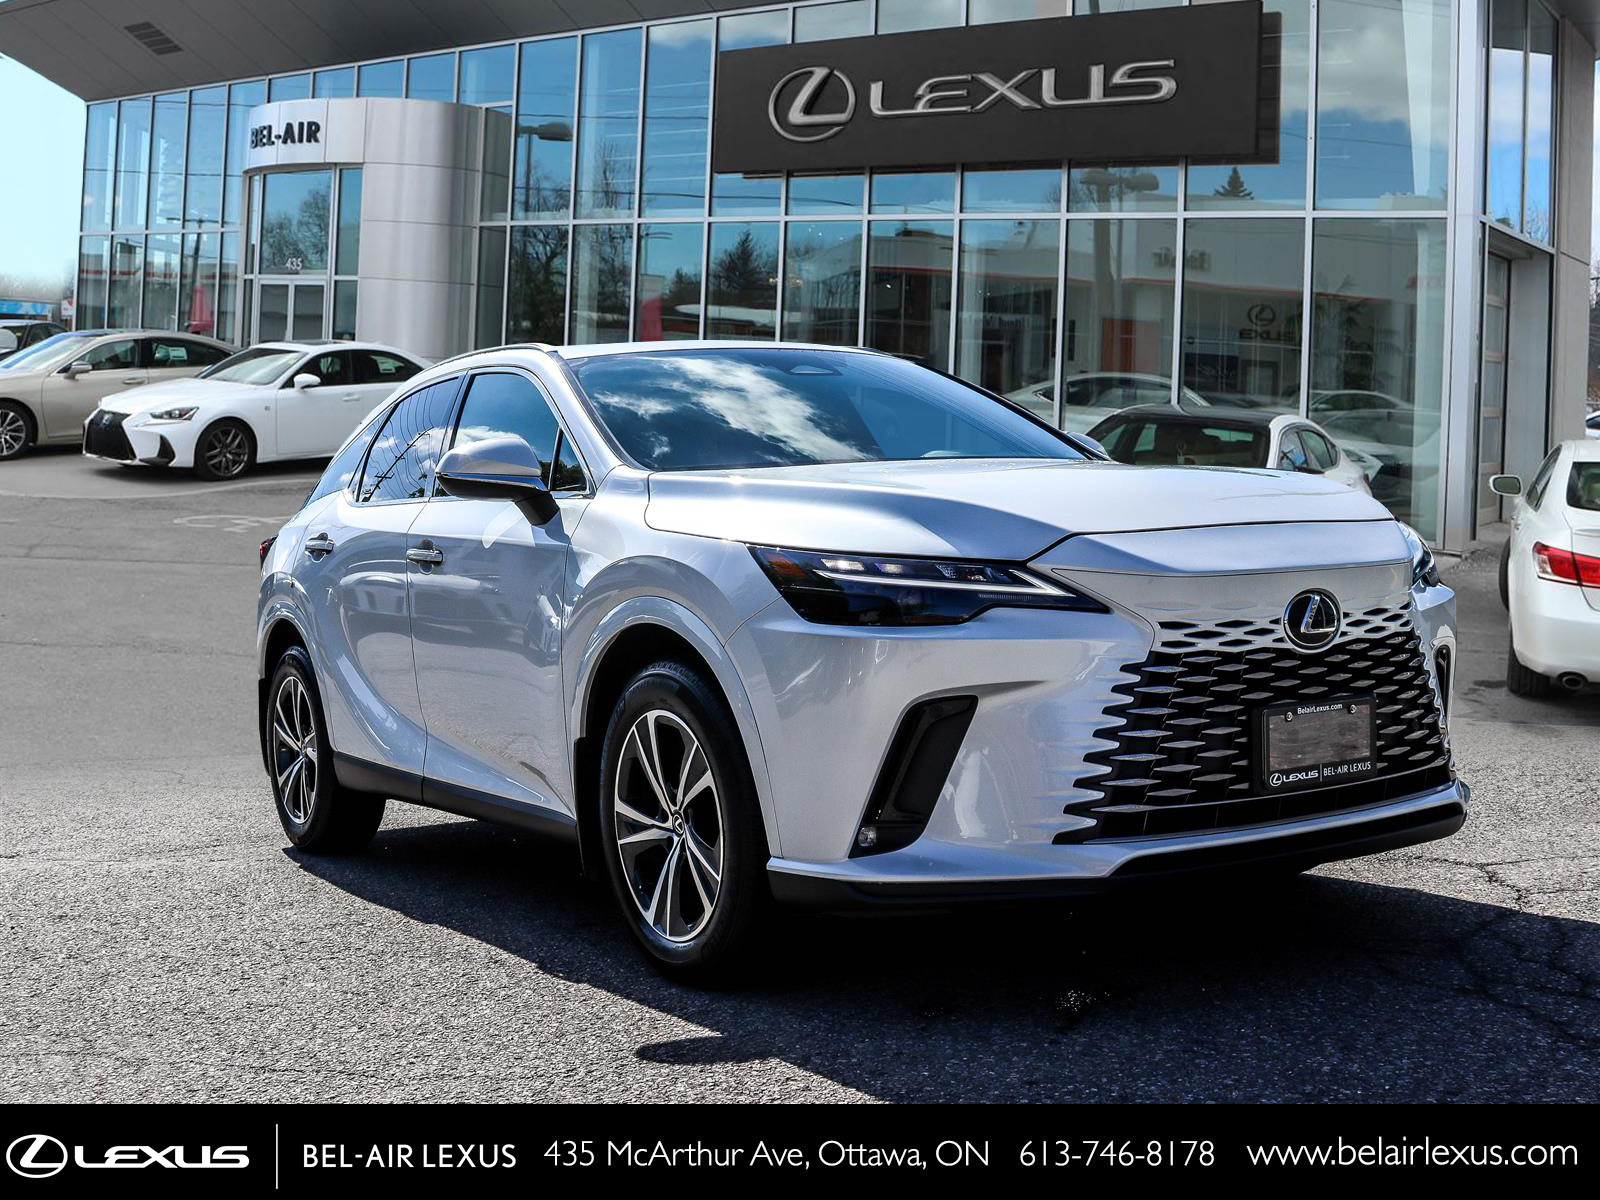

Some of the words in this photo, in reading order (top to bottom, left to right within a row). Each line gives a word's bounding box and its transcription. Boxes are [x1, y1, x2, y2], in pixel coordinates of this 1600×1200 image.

[870, 59, 1178, 118] LEXUS
[250, 120, 321, 149] BEL-AIR
[285, 257, 303, 270] 435
[1297, 703, 1343, 714] BelairLexus.com
[1323, 764, 1349, 776] BEL-AIR
[1349, 761, 1371, 773] LEXUS
[1283, 770, 1319, 782] LEXUS
